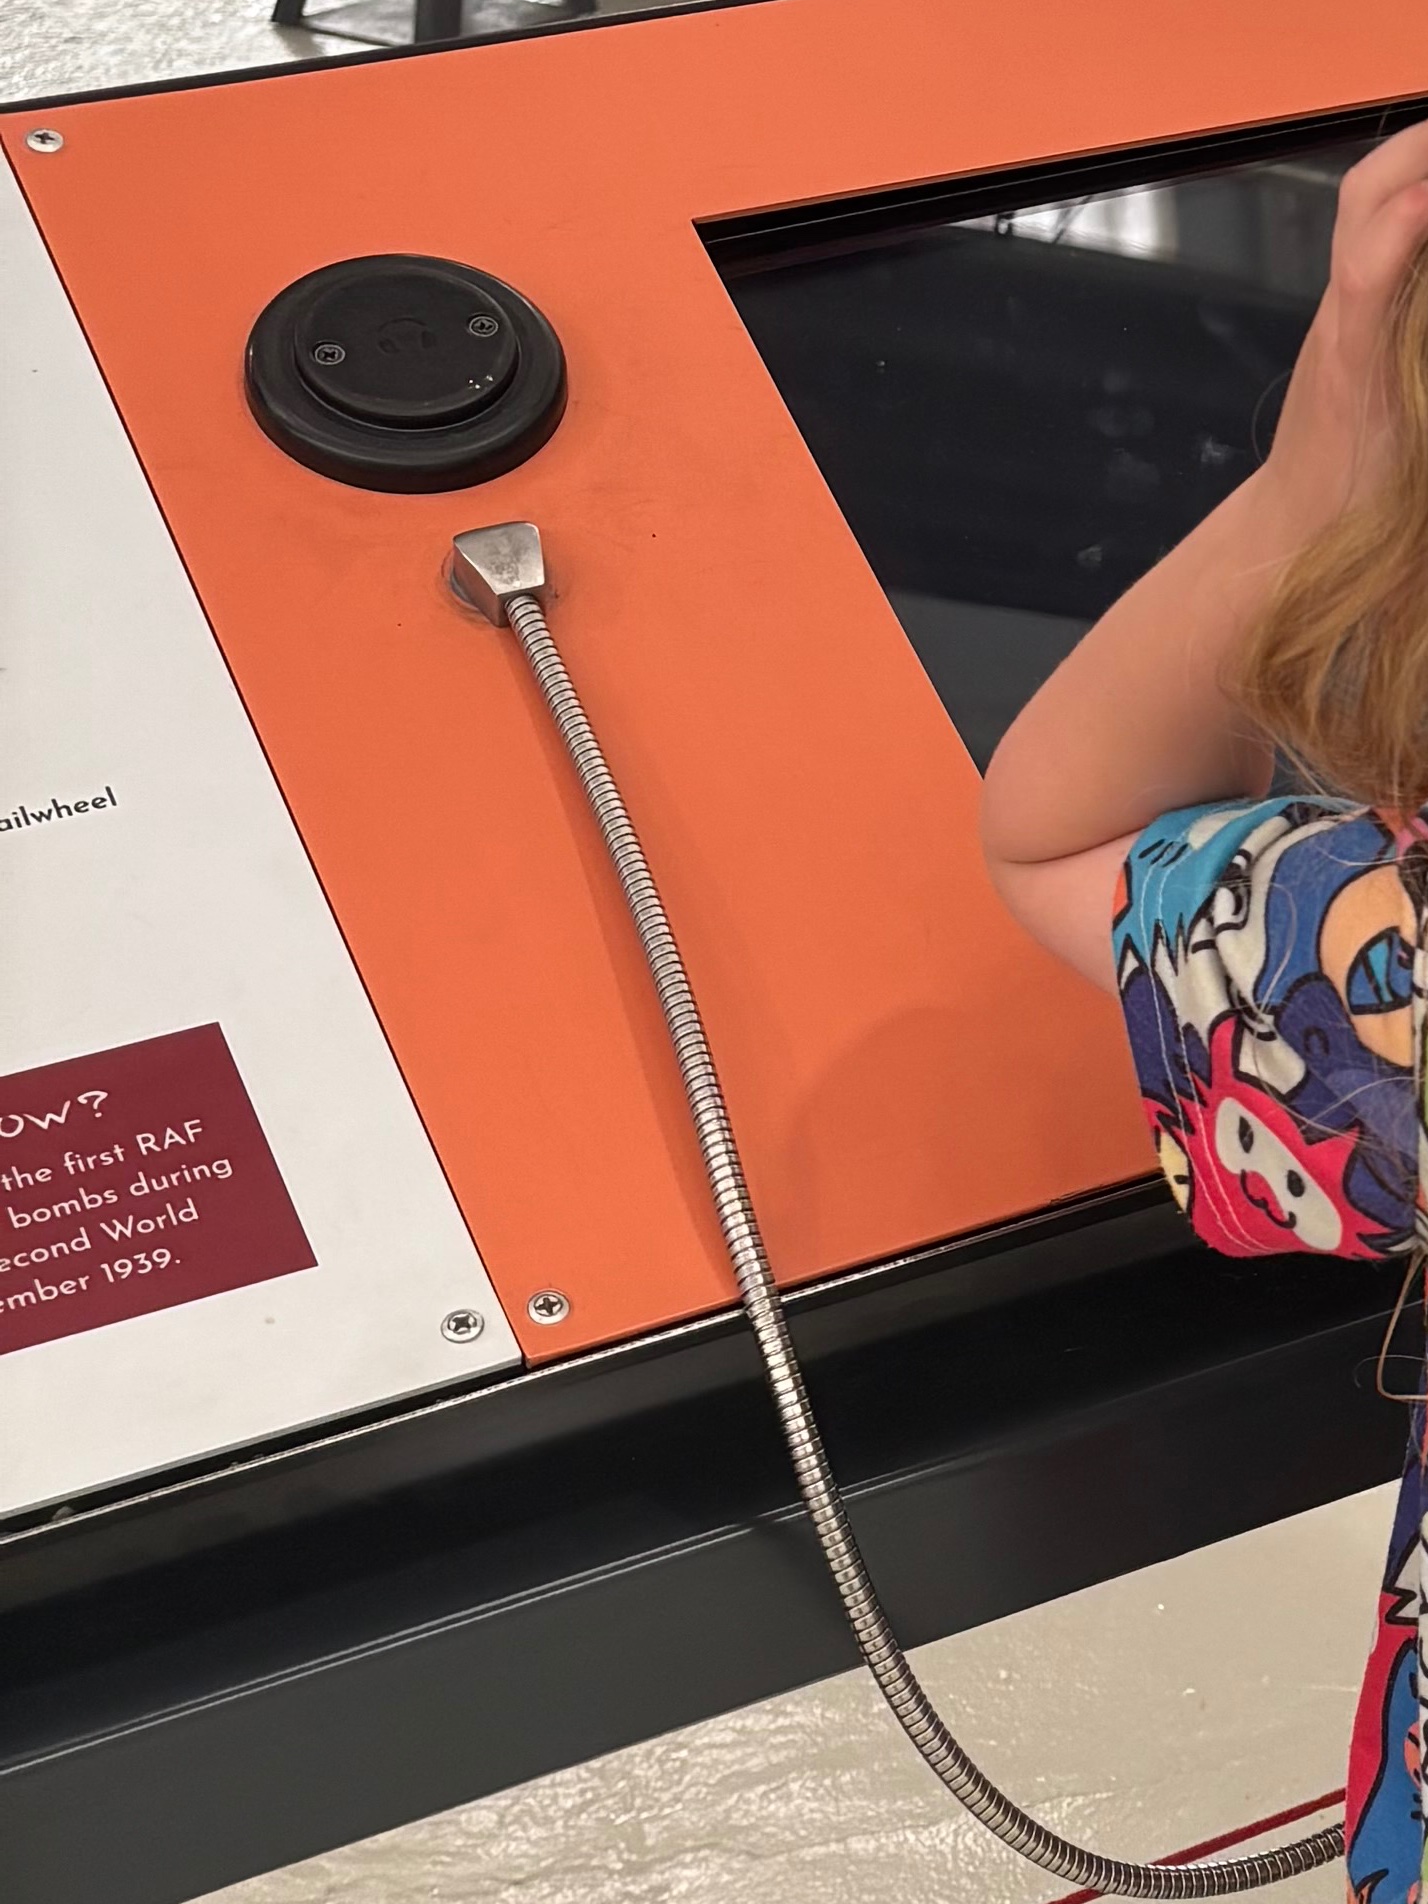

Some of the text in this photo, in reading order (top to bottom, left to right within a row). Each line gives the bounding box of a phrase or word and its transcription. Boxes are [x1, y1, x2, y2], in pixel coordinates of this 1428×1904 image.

[0, 786, 117, 832] ailwheel
[1, 1119, 203, 1191] the first RAF
[7, 1158, 233, 1228] bombs during
[0, 1197, 199, 1273] econd World
[0, 1248, 181, 1314] mber 1939.
